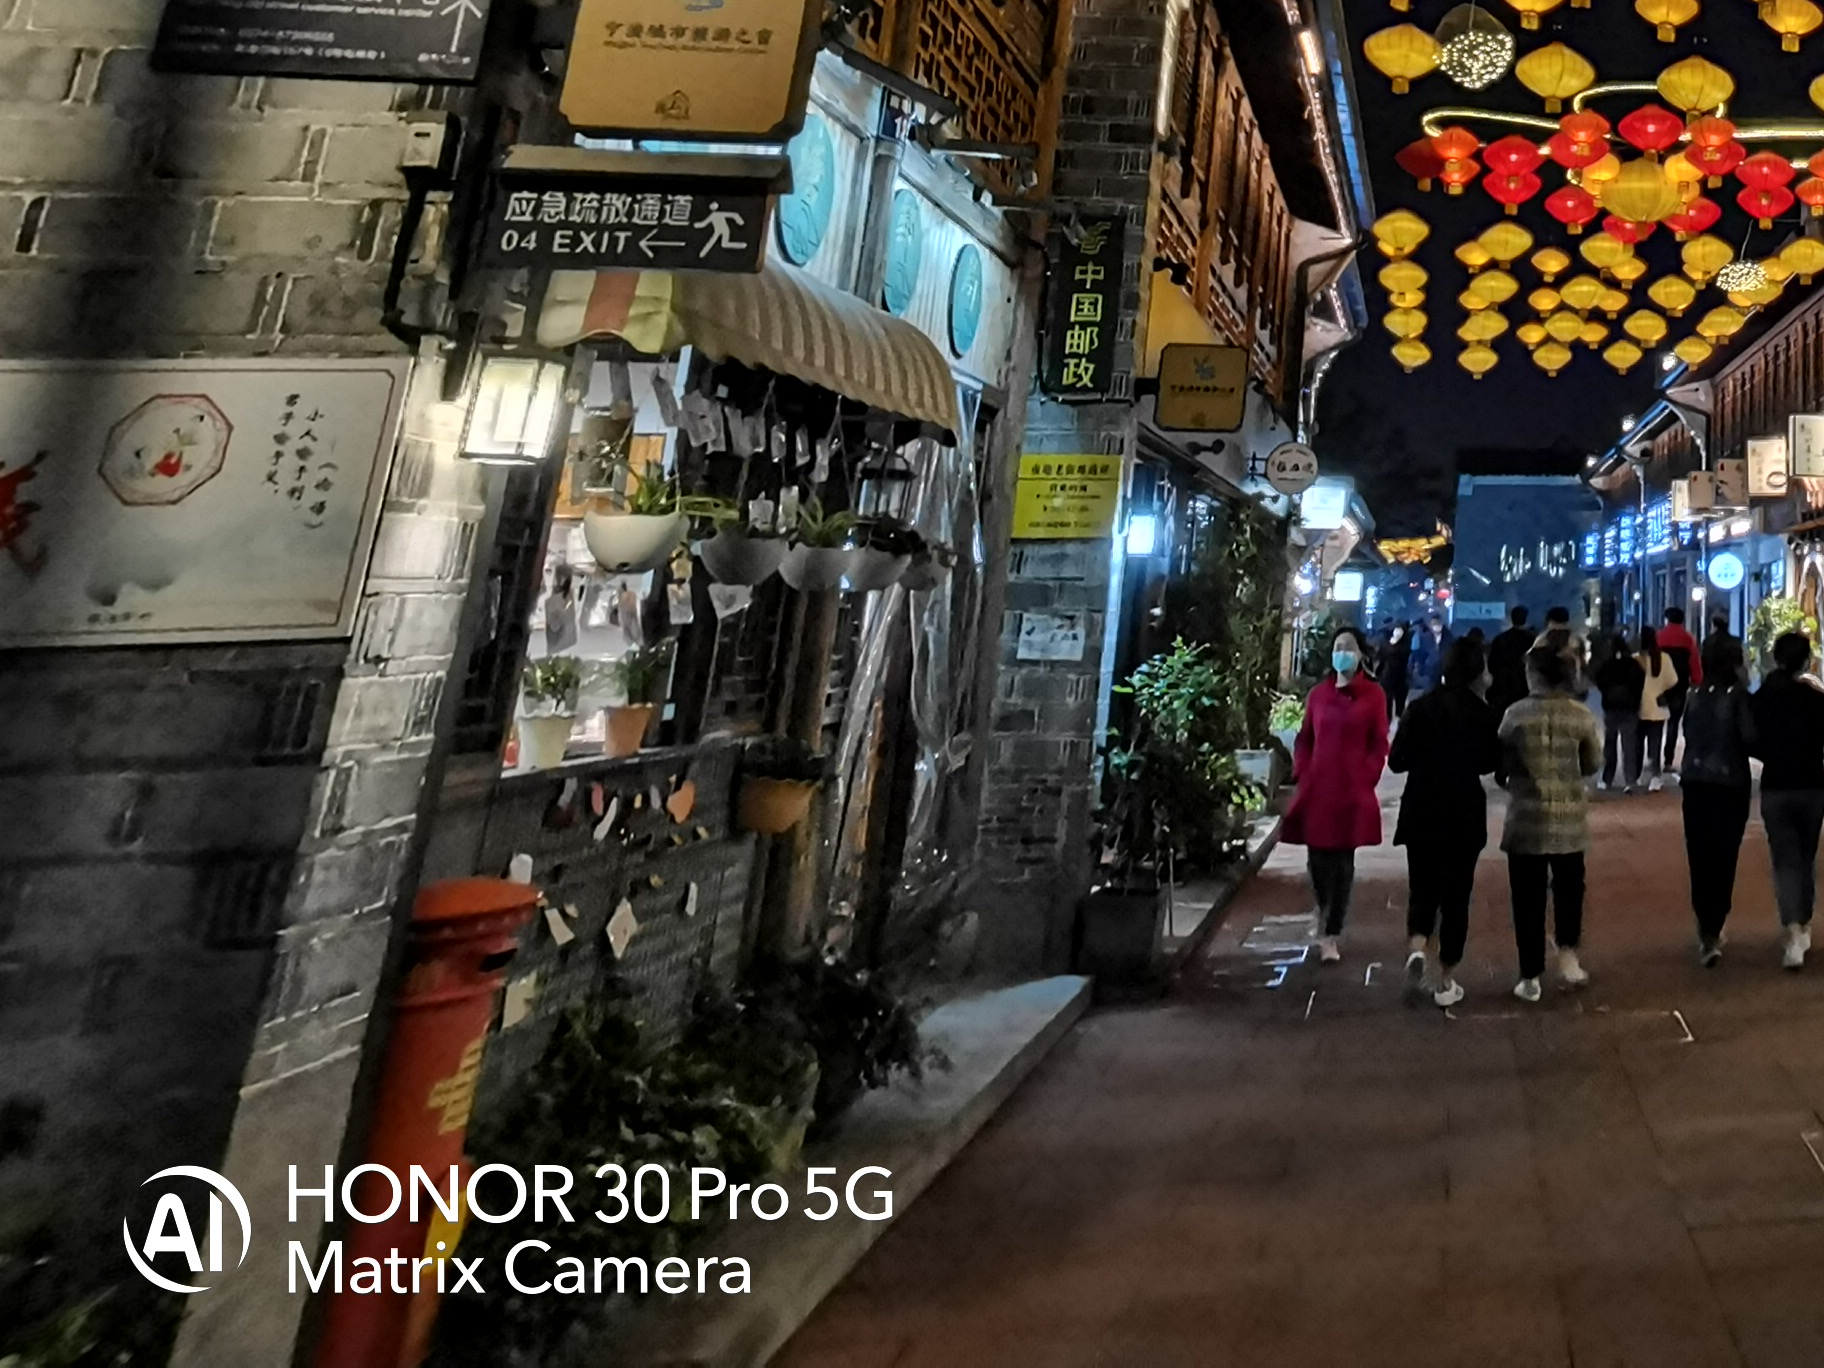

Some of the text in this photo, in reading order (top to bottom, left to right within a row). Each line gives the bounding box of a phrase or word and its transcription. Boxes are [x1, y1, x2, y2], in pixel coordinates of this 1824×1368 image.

[504, 190, 694, 226] 应急疏散通道
[501, 229, 633, 254] 04 EXIT
[1061, 260, 1105, 389] 中国邮政
